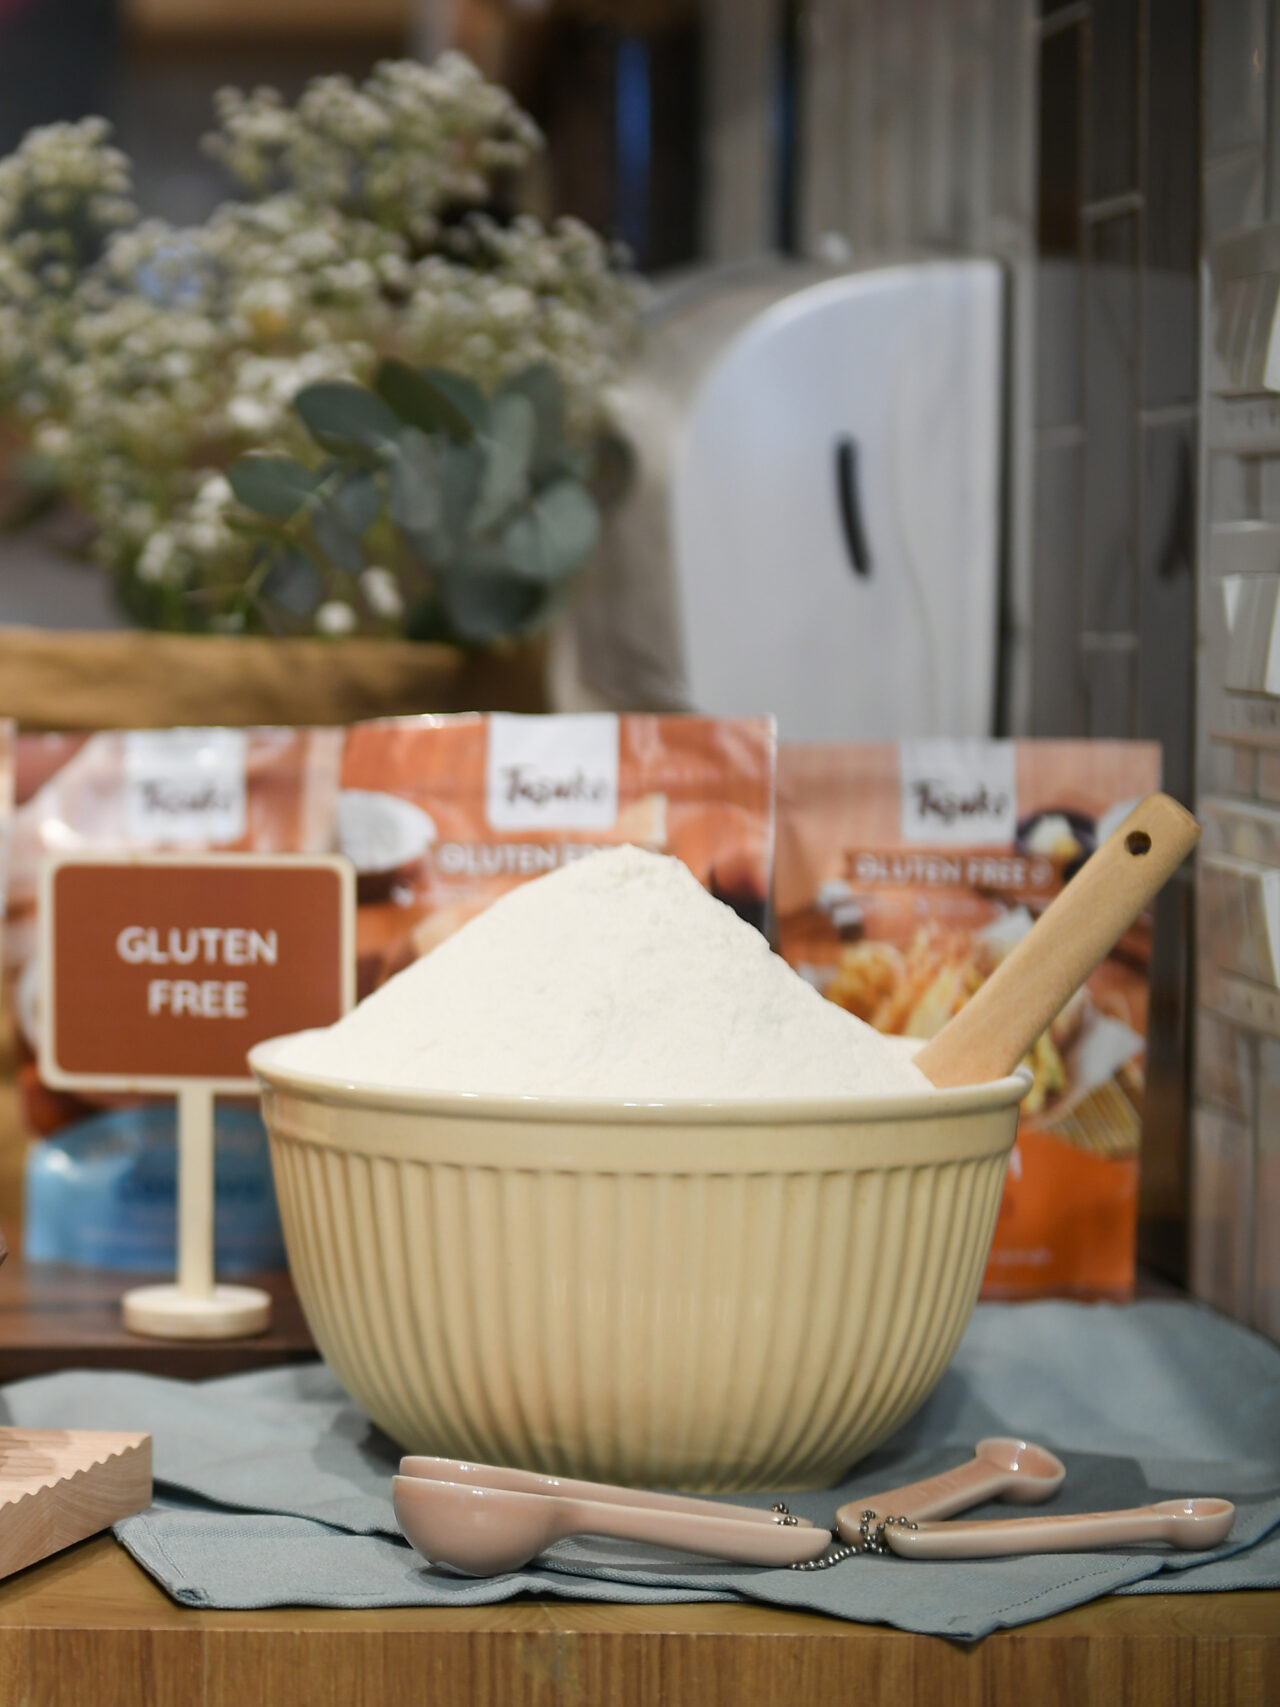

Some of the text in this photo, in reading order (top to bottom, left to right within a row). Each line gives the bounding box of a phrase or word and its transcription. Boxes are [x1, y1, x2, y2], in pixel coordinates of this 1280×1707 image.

[438, 842, 557, 875] GLUTEN
[856, 854, 1026, 888] GLUTEN FREE
[116, 925, 278, 966] GLUTEN
[148, 979, 249, 1019] FREE
